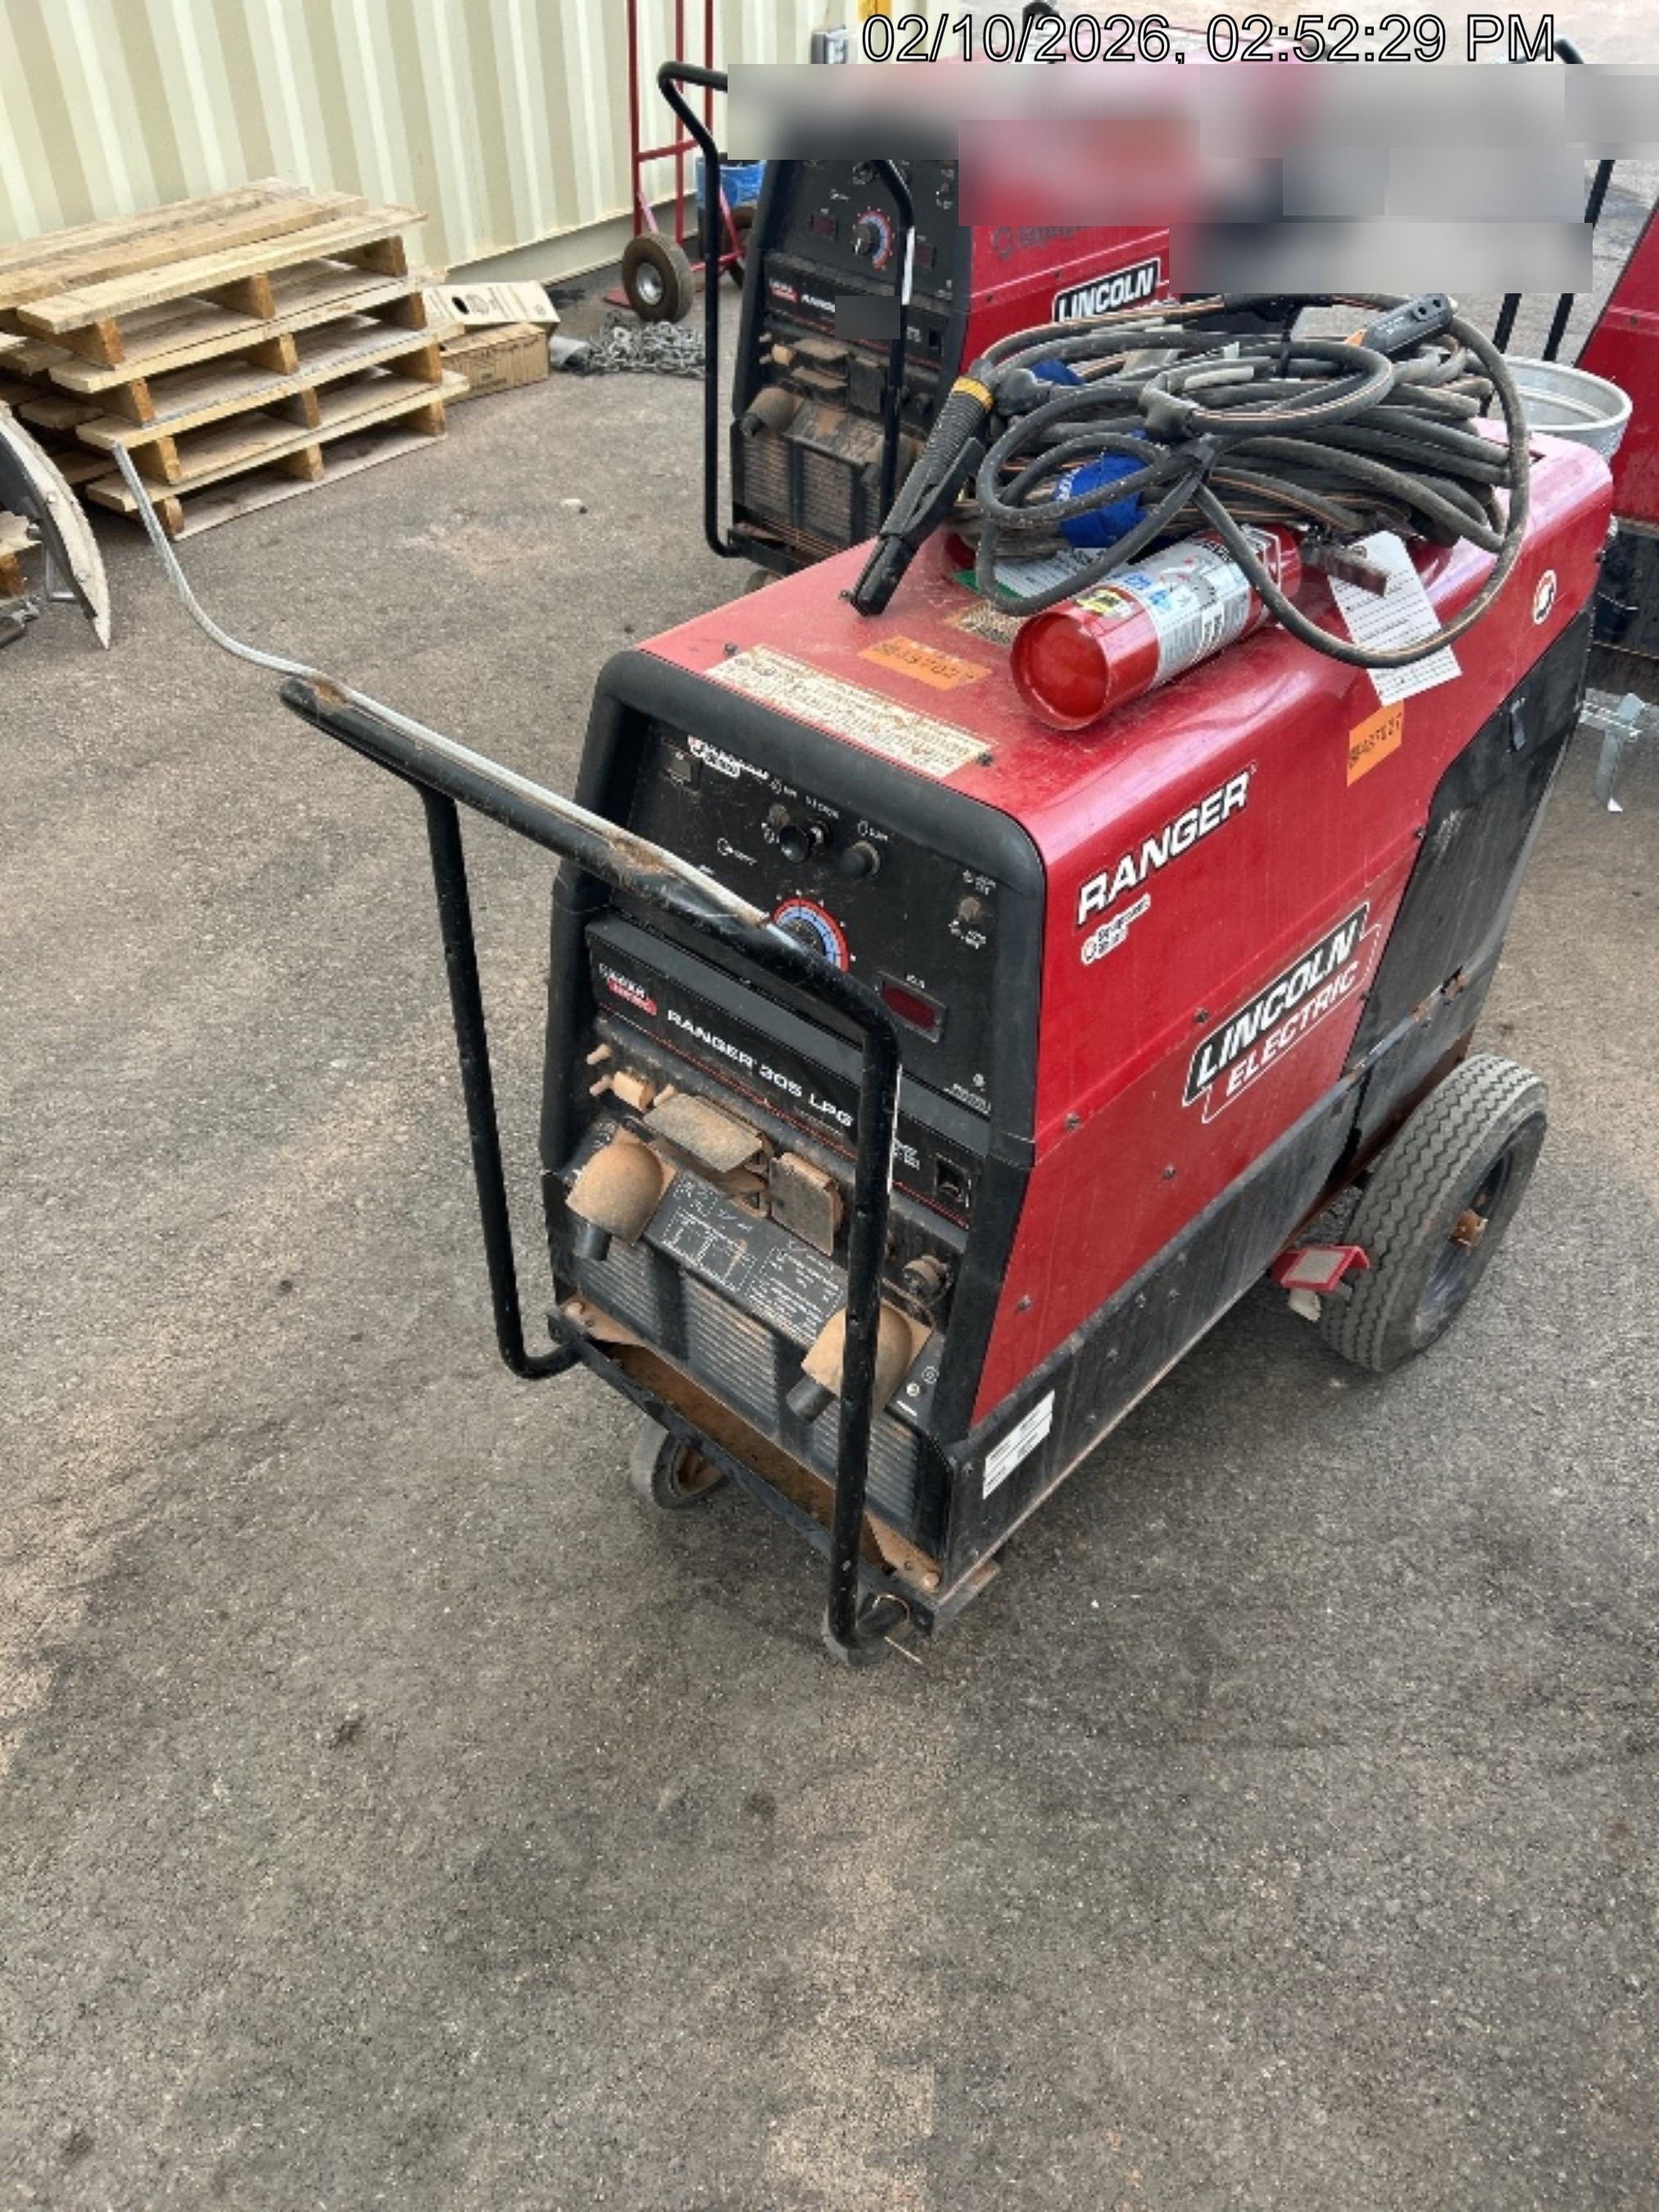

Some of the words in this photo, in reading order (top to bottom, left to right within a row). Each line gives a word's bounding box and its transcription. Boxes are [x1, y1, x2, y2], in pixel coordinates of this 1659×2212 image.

[1057, 266, 1155, 322] LINCOLN
[1077, 770, 1250, 927] RANGER
[666, 1008, 755, 1068] RANGER
[758, 1063, 803, 1098] 305
[807, 1091, 855, 1128] LPG
[1196, 918, 1359, 1088] LINCOLN
[1226, 960, 1360, 1098] ELECTRIC
